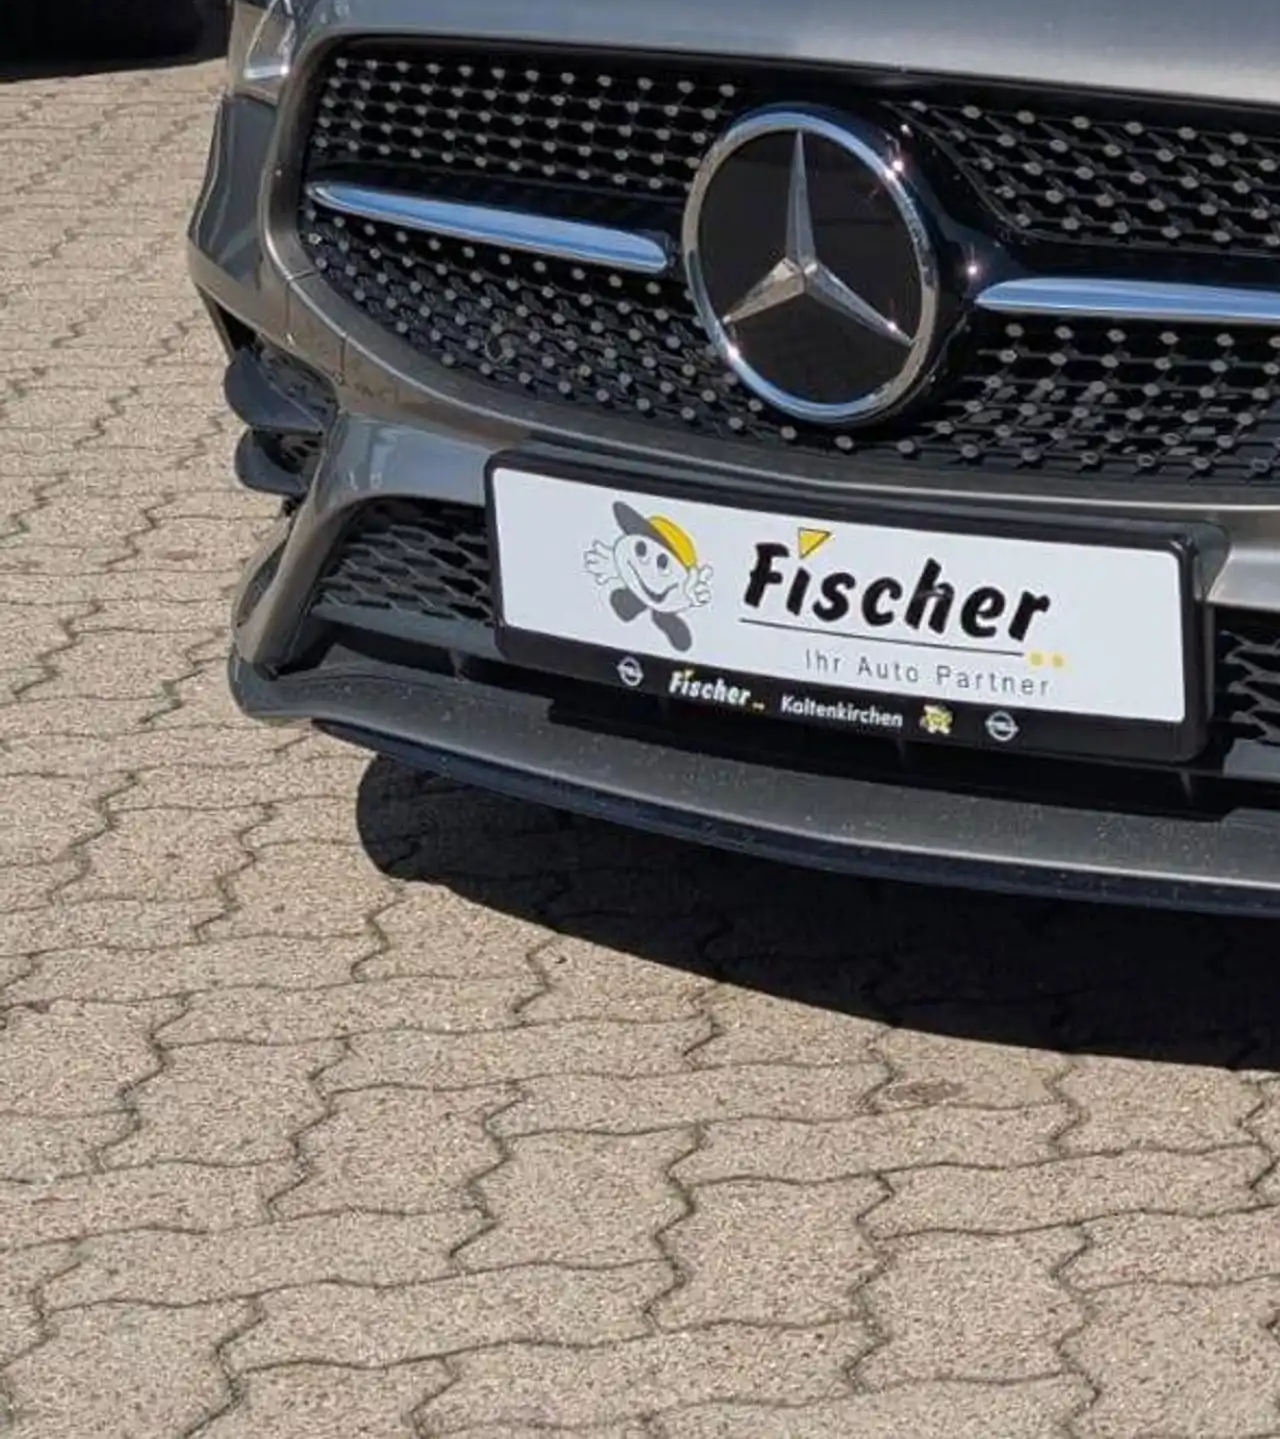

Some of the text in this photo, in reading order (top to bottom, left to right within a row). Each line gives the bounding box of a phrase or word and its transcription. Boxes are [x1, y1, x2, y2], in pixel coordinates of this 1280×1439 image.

[743, 541, 1051, 642] Fischer
[668, 668, 904, 728] Fischer Kaltenkirchen
[805, 648, 1051, 697] Ihr Auto Partner
